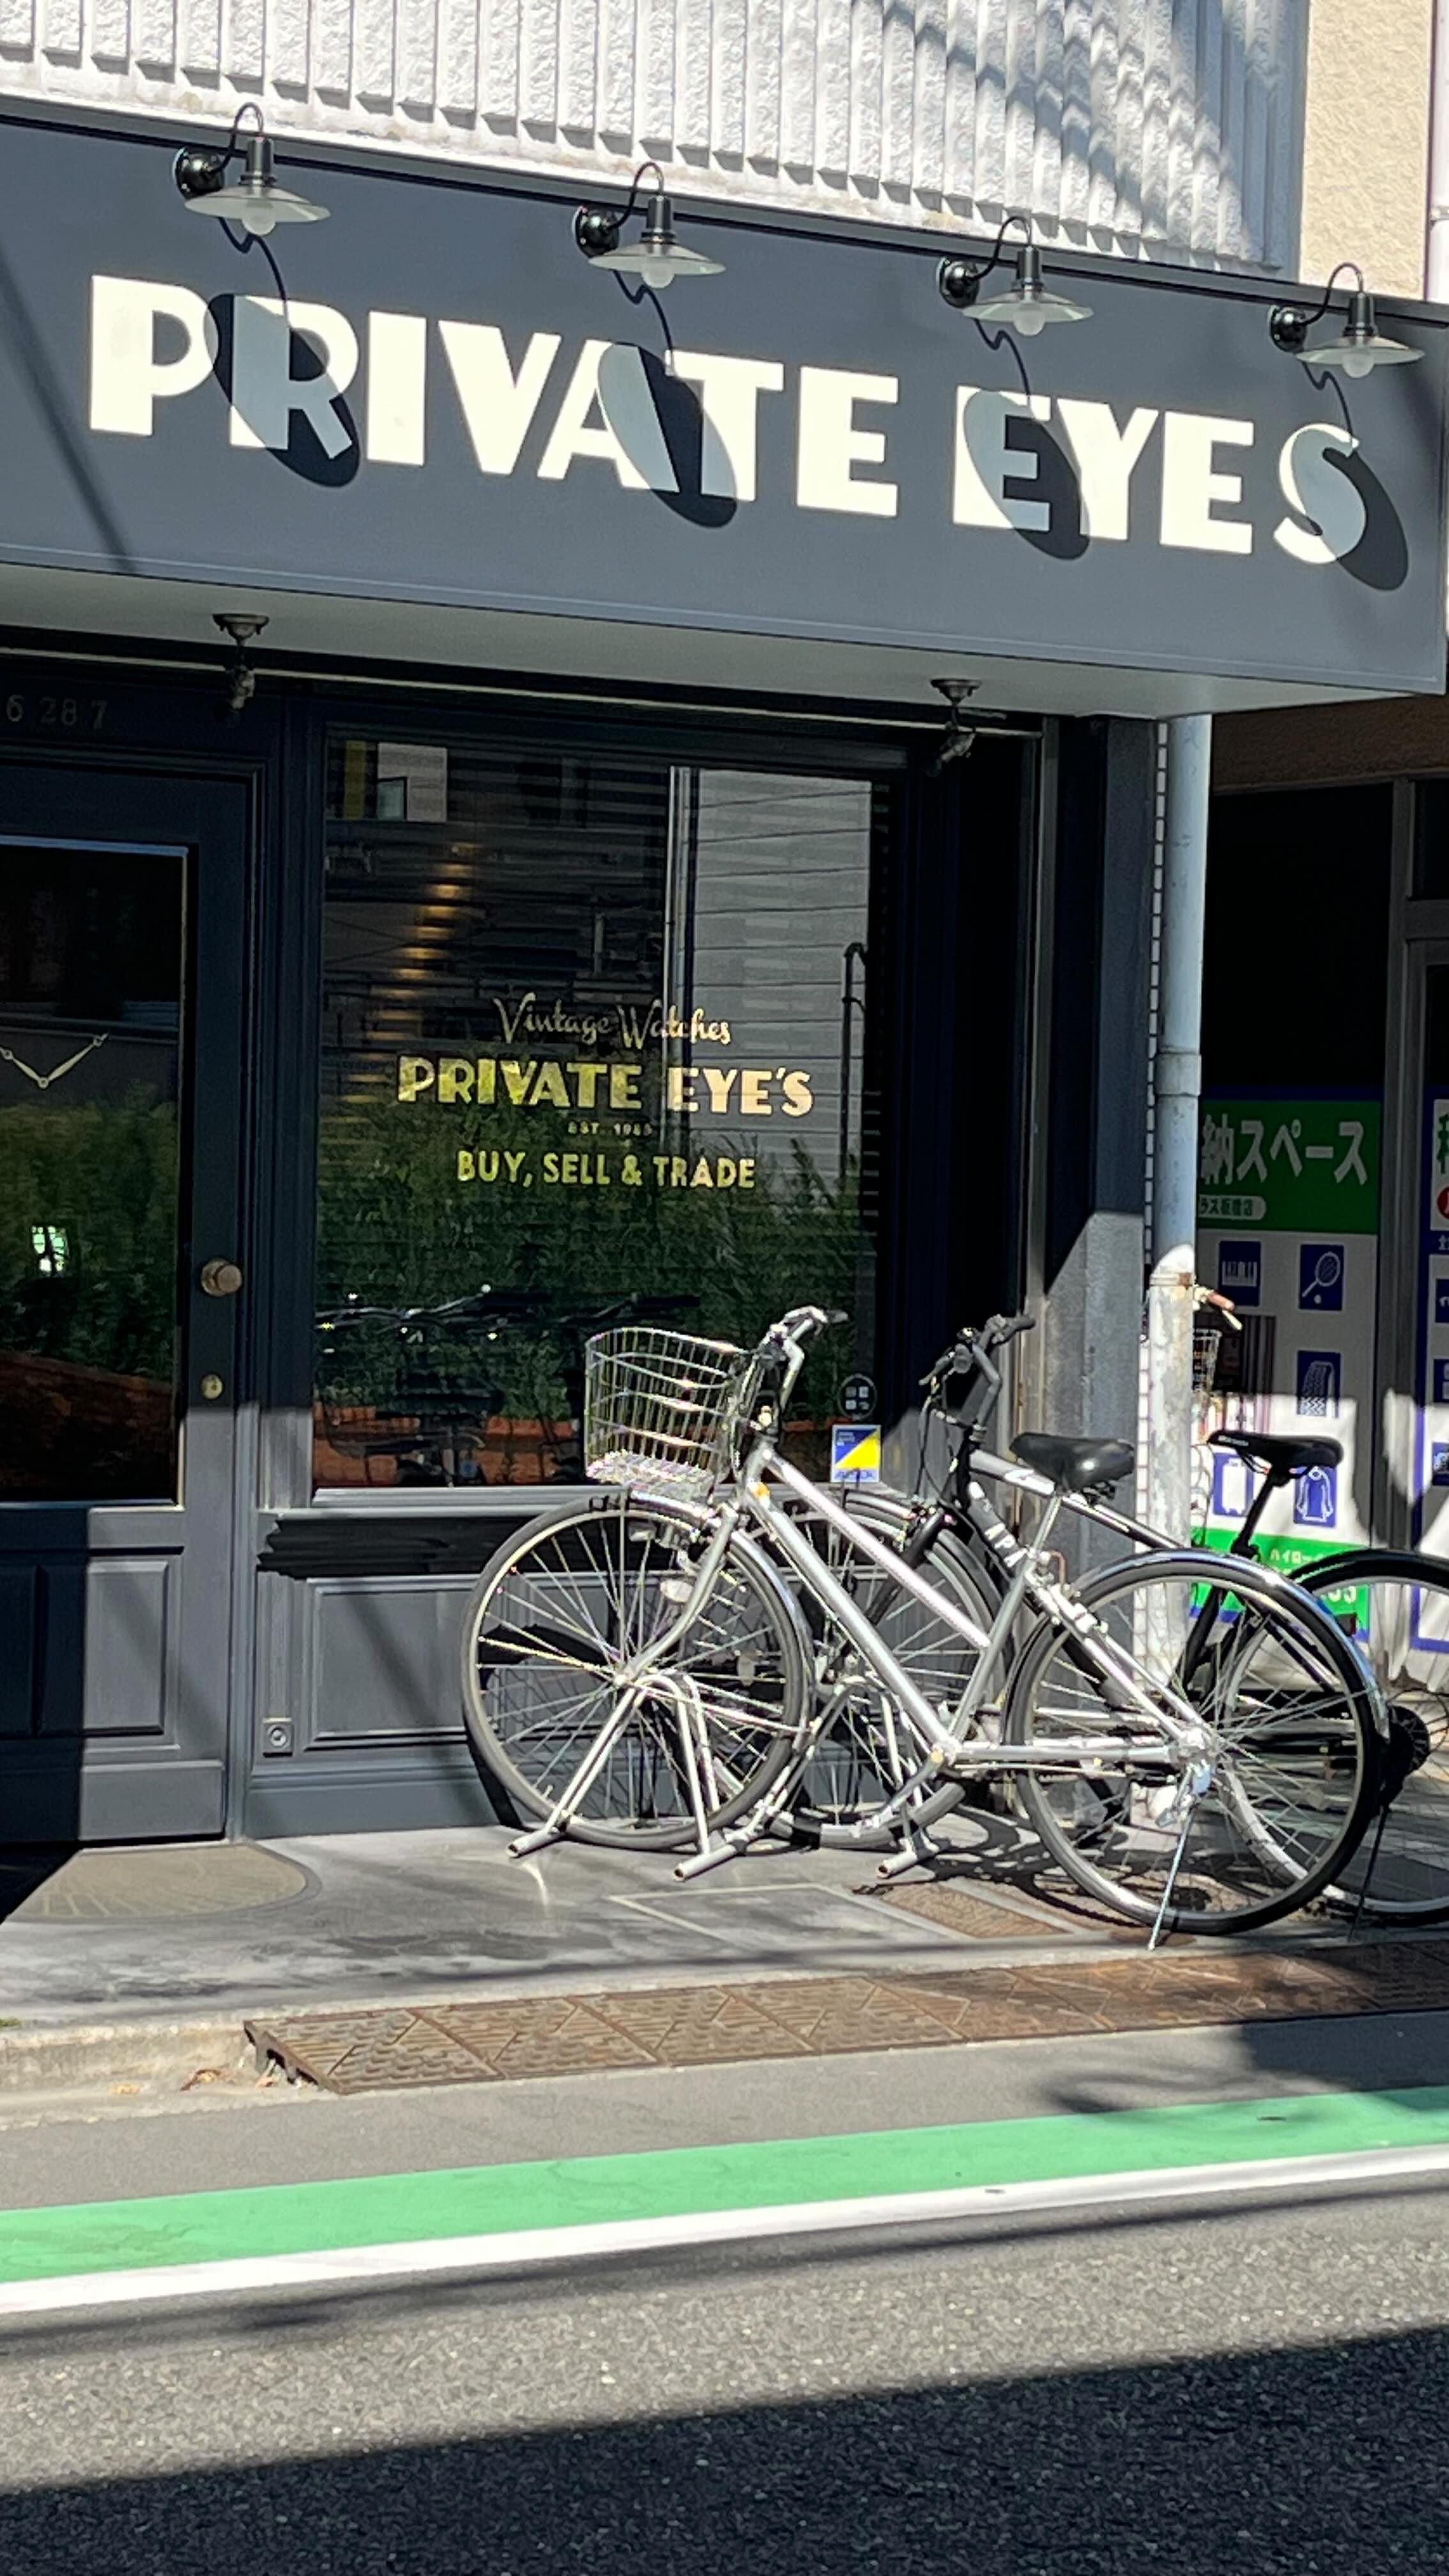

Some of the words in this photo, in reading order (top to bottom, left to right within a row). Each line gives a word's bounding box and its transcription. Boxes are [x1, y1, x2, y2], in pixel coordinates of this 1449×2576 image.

[89, 273, 899, 519] PRIVATE
[952, 384, 1367, 566] EYES
[493, 992, 611, 1045] Vintage
[617, 999, 731, 1050] Watches
[397, 1054, 642, 1109] PRIVATE
[666, 1065, 813, 1117] EYE'S
[457, 1150, 533, 1187] BUY,
[543, 1153, 611, 1185] SELL
[621, 1154, 642, 1186] &
[652, 1156, 756, 1188] TRADE
